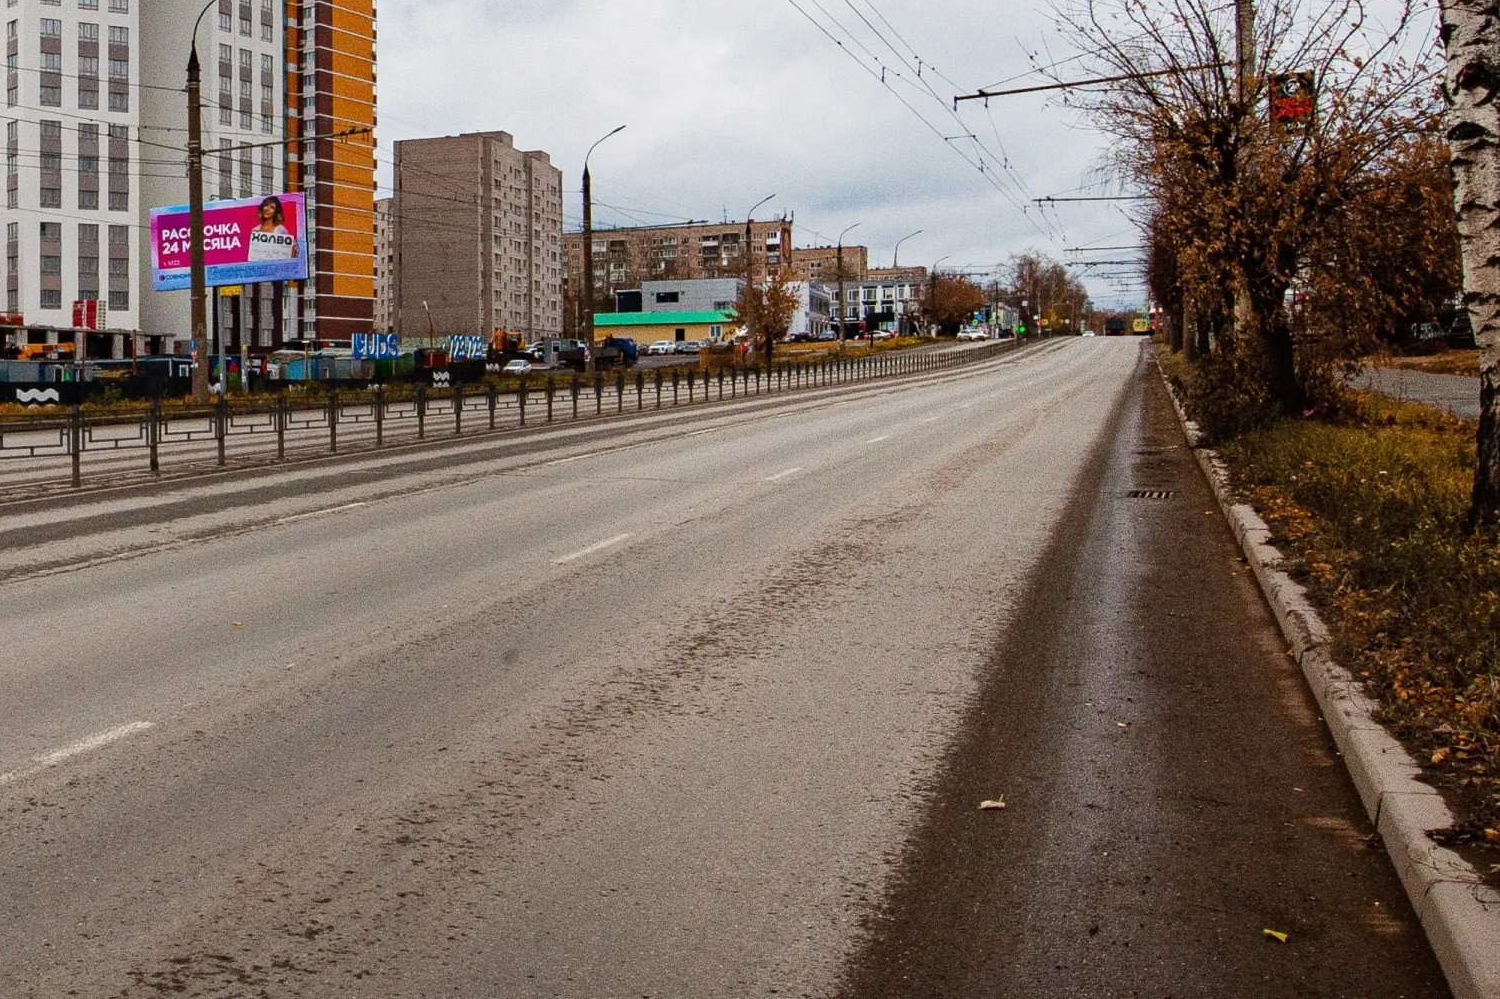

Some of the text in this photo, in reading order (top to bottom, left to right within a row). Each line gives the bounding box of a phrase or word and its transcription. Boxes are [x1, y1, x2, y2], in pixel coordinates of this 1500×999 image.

[162, 222, 241, 241] РАСОЧКА
[162, 236, 242, 255] 24 МСЯЦА
